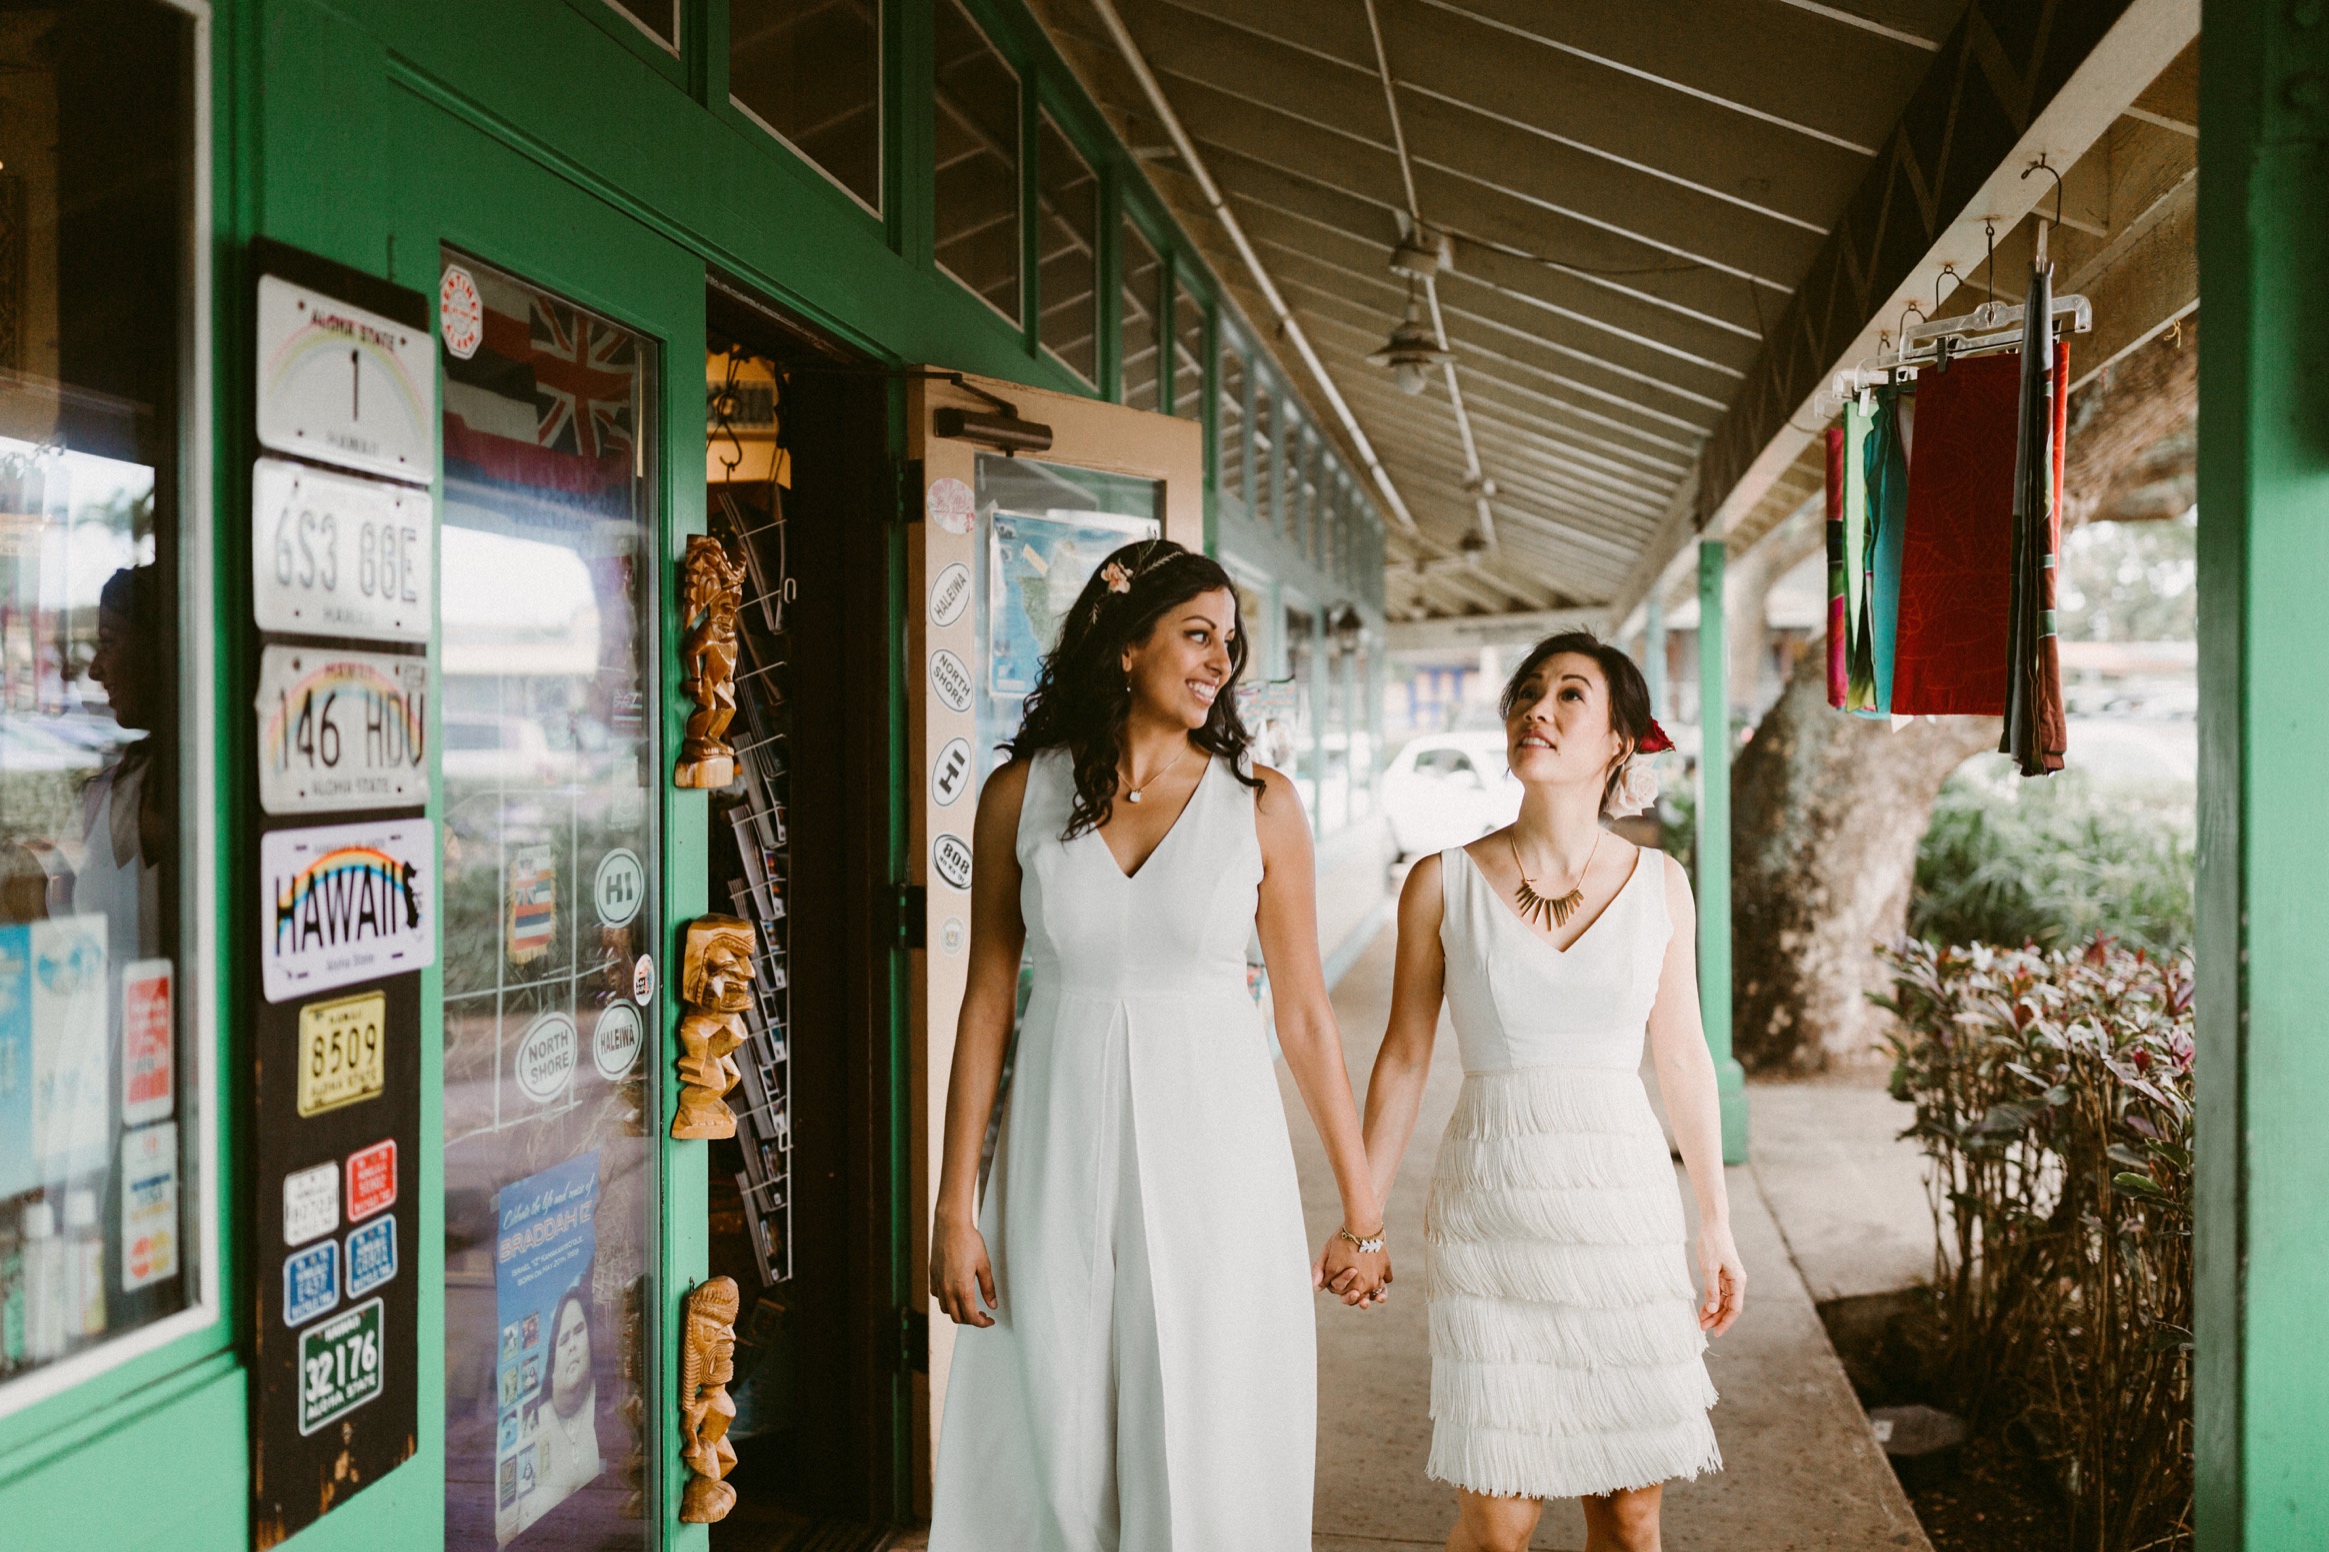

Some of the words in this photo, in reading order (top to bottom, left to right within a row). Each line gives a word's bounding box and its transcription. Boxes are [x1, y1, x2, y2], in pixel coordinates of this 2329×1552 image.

[444, 324, 476, 349] ALARM
[933, 572, 967, 619] HALEIWA
[933, 666, 965, 707] SHORE
[939, 654, 971, 696] NORTH
[280, 687, 340, 768] 146
[938, 748, 966, 795] HI
[943, 843, 970, 875] 808
[275, 860, 396, 957] HAWAII
[605, 871, 633, 905] HI
[312, 1023, 377, 1079] 8509
[528, 1028, 569, 1064] NORTH
[530, 1051, 570, 1085] SHORE
[500, 1208, 577, 1264] BRADDAH
[305, 1329, 378, 1403] 32176
